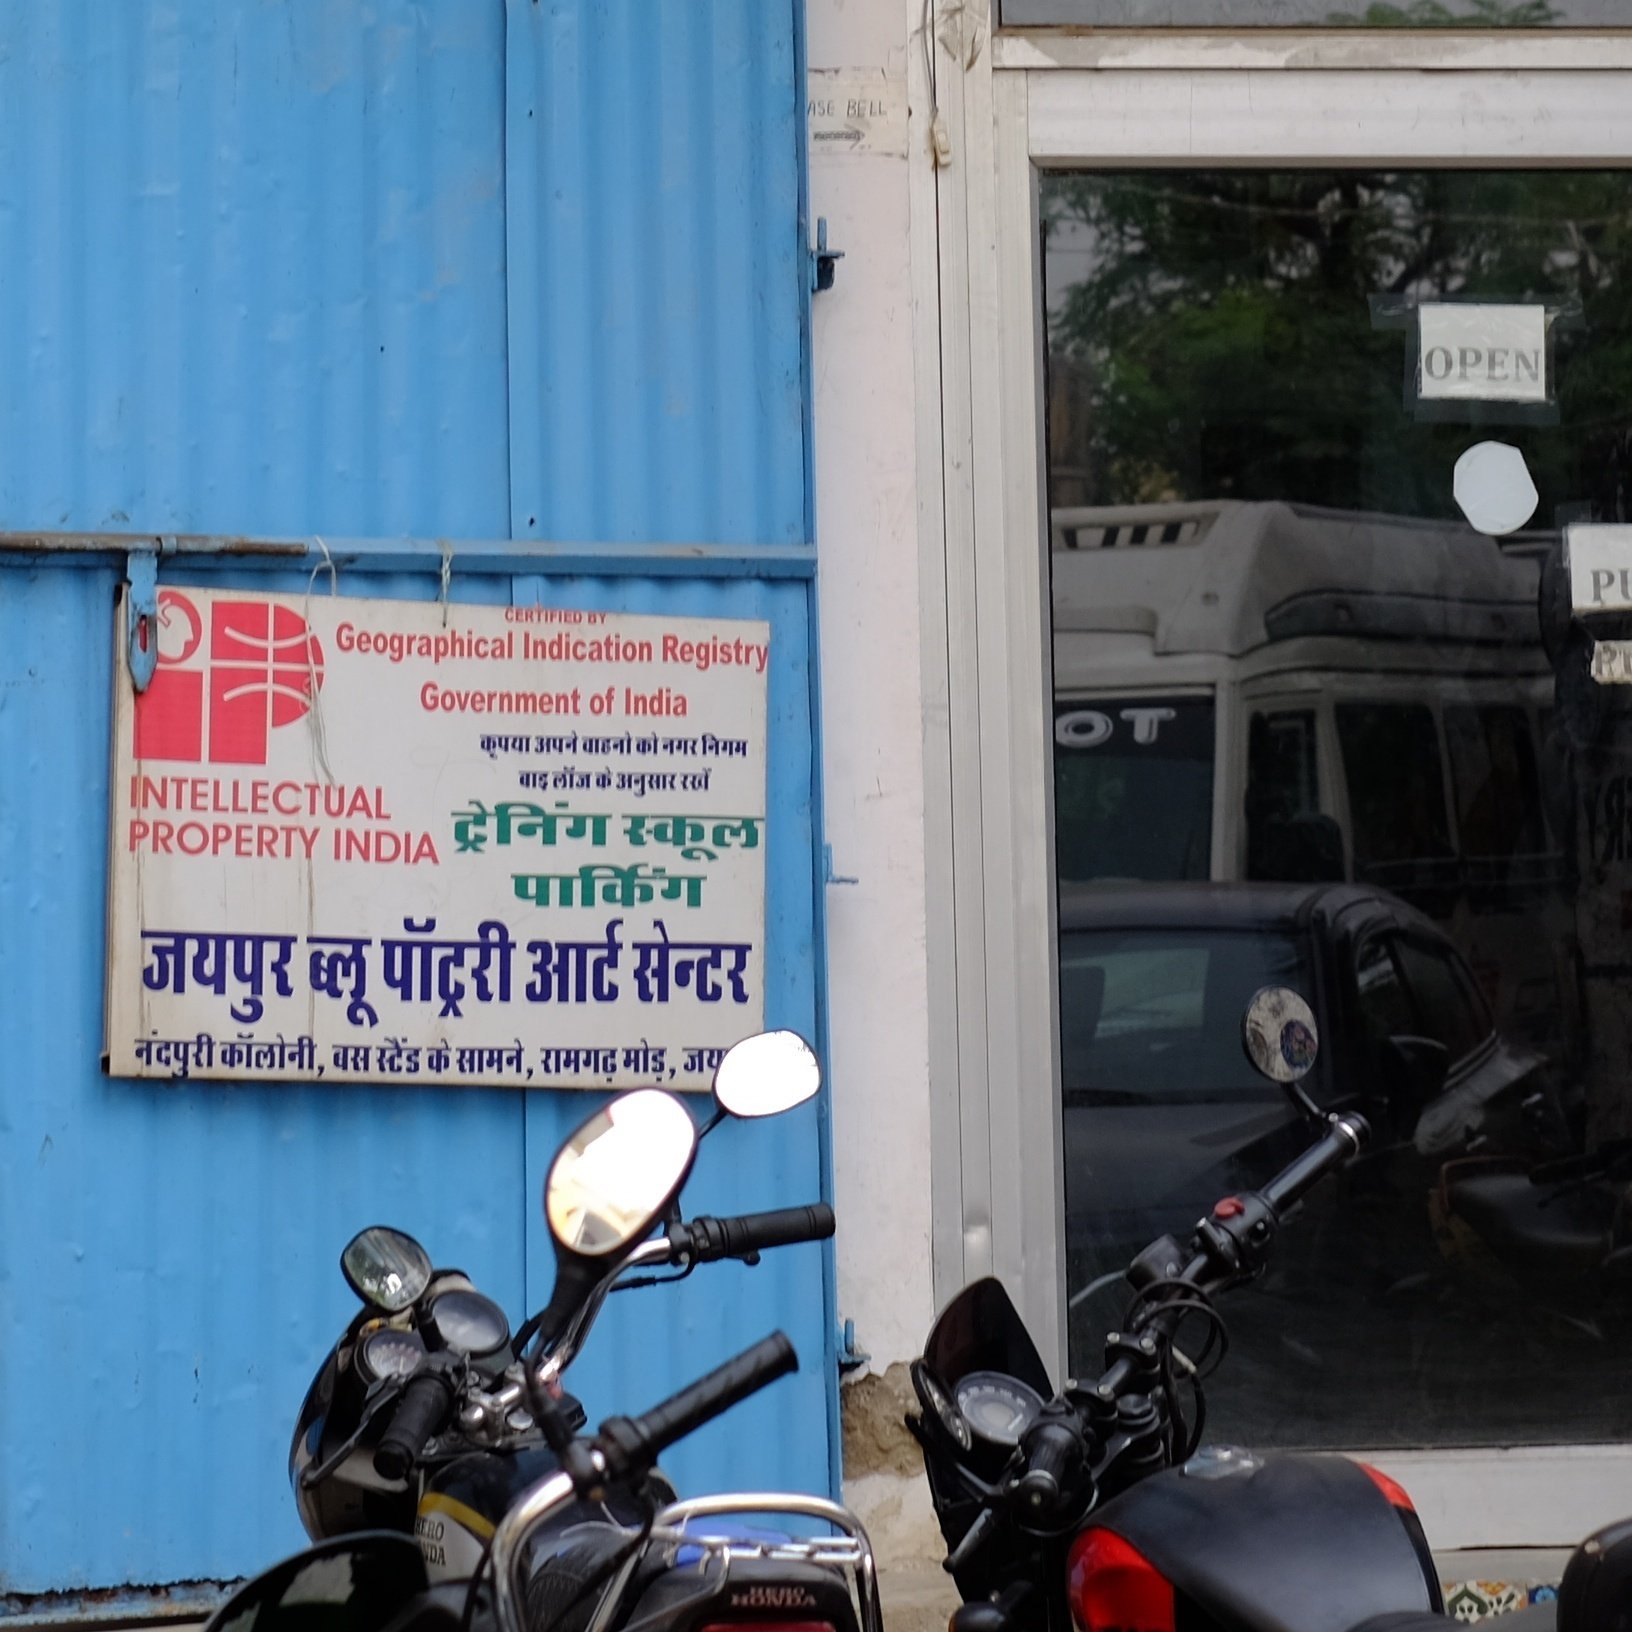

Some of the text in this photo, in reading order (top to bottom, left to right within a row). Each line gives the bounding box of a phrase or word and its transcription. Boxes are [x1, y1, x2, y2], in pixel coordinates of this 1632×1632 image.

[846, 99, 888, 118] BELL
[1424, 345, 1542, 382] OPEN
[504, 607, 607, 625] CERTIFIED BY
[335, 621, 768, 674] Geographical Indication Registry
[420, 680, 688, 717] Government of India
[534, 730, 578, 754] अपने
[635, 731, 658, 756] को
[662, 737, 699, 756] नगर
[701, 733, 749, 757] निगम
[130, 775, 391, 819] INTELLECTUAL
[616, 770, 678, 797] अनुसार
[129, 819, 440, 866] PROPERTY INDIA
[451, 800, 765, 861] ट्रेनिंग स्कूल
[510, 862, 708, 908] पार्किंग
[140, 929, 298, 1024] जयपुर
[306, 936, 379, 1028] ब्लू
[525, 918, 624, 1003] आर्ट
[632, 918, 753, 1004] सेन्टर
[426, 1037, 452, 1074] के
